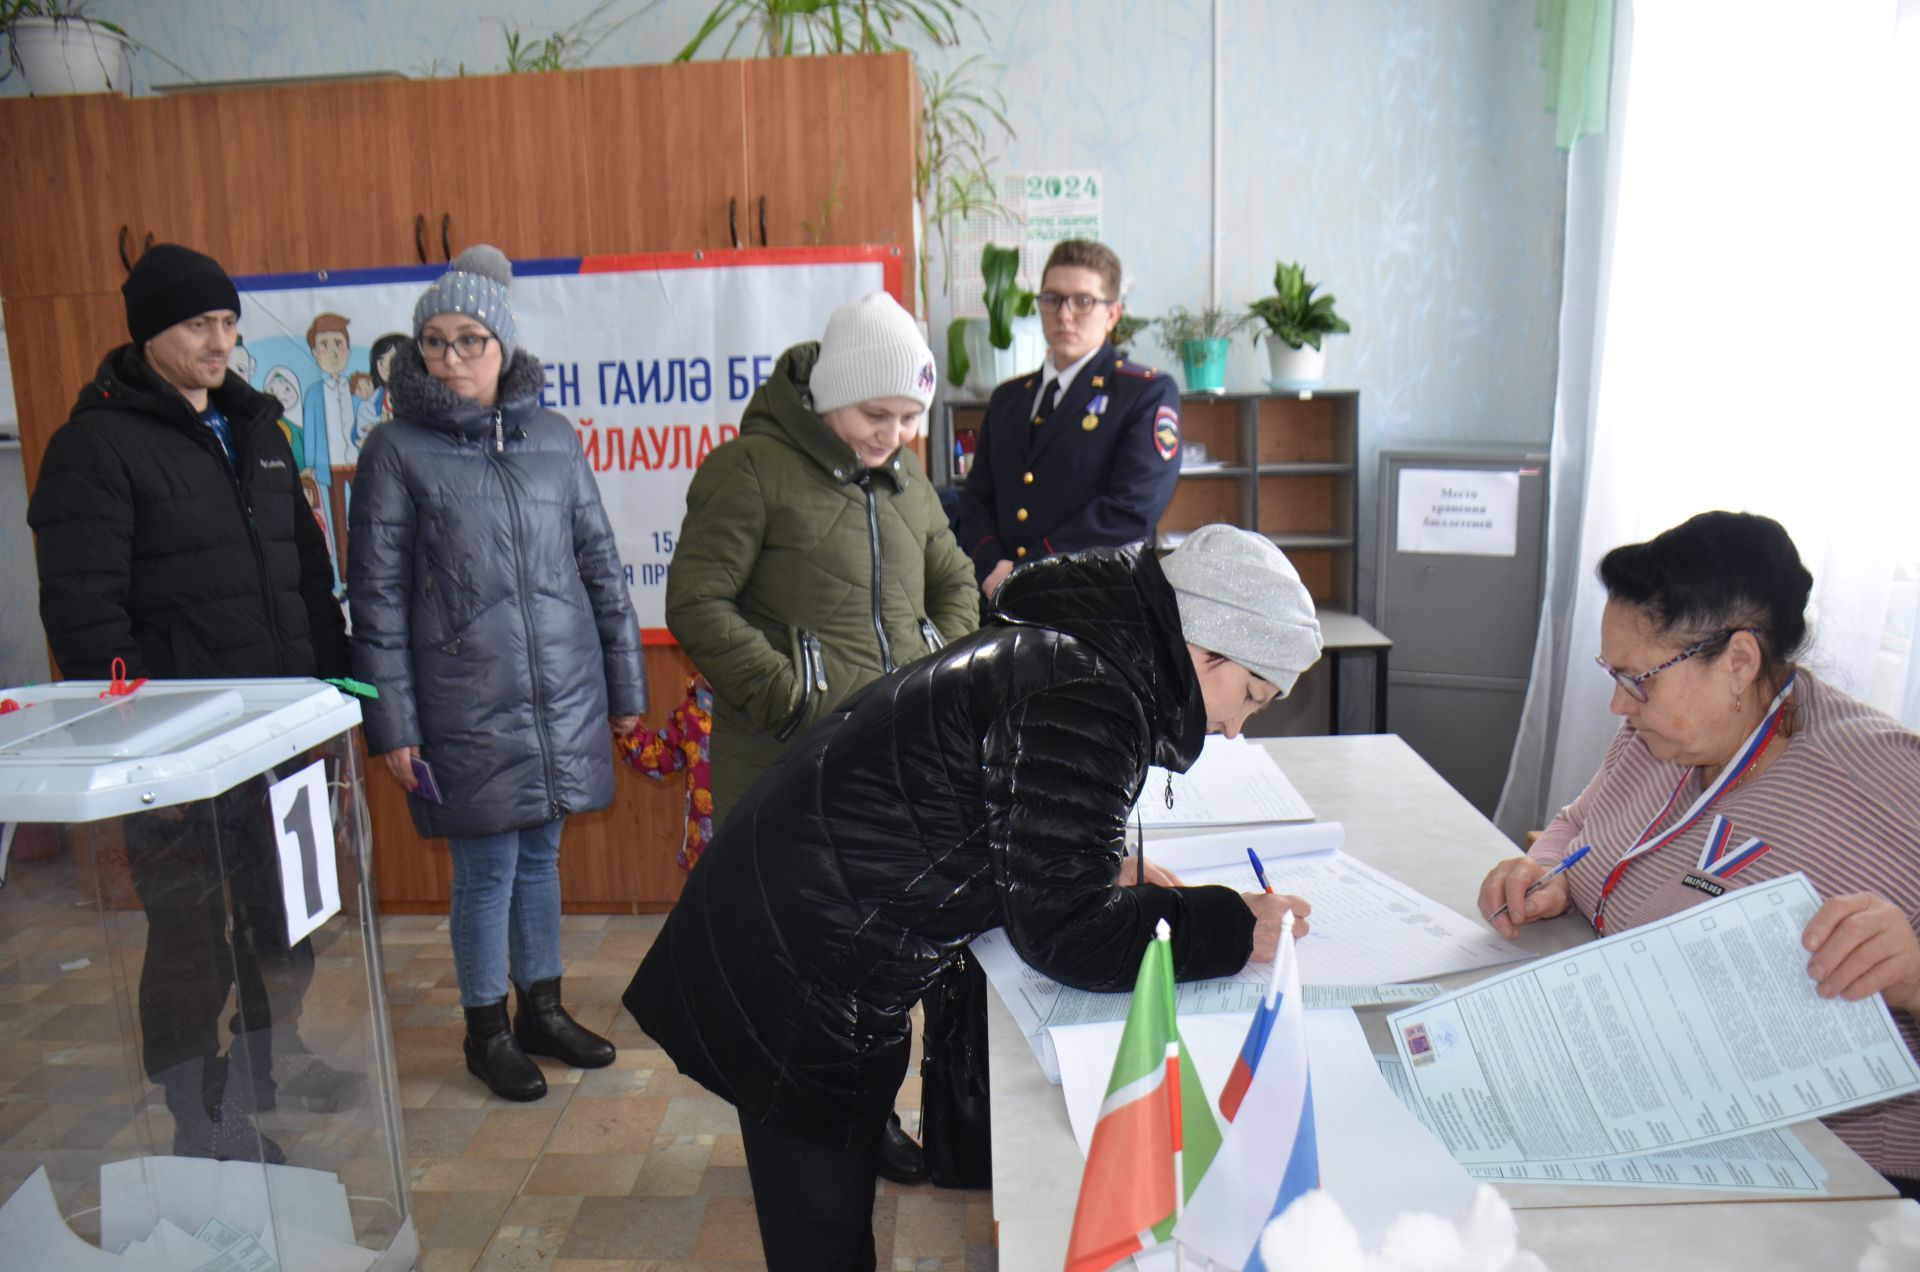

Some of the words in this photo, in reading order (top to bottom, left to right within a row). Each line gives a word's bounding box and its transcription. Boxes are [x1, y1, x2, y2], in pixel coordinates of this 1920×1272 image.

[1027, 175, 1098, 199] 2024
[538, 362, 580, 407] ЕН
[598, 356, 712, 405] ГАИЛӘ
[728, 355, 772, 401] БЕ
[642, 563, 670, 585] ПР
[283, 784, 324, 919] 1
